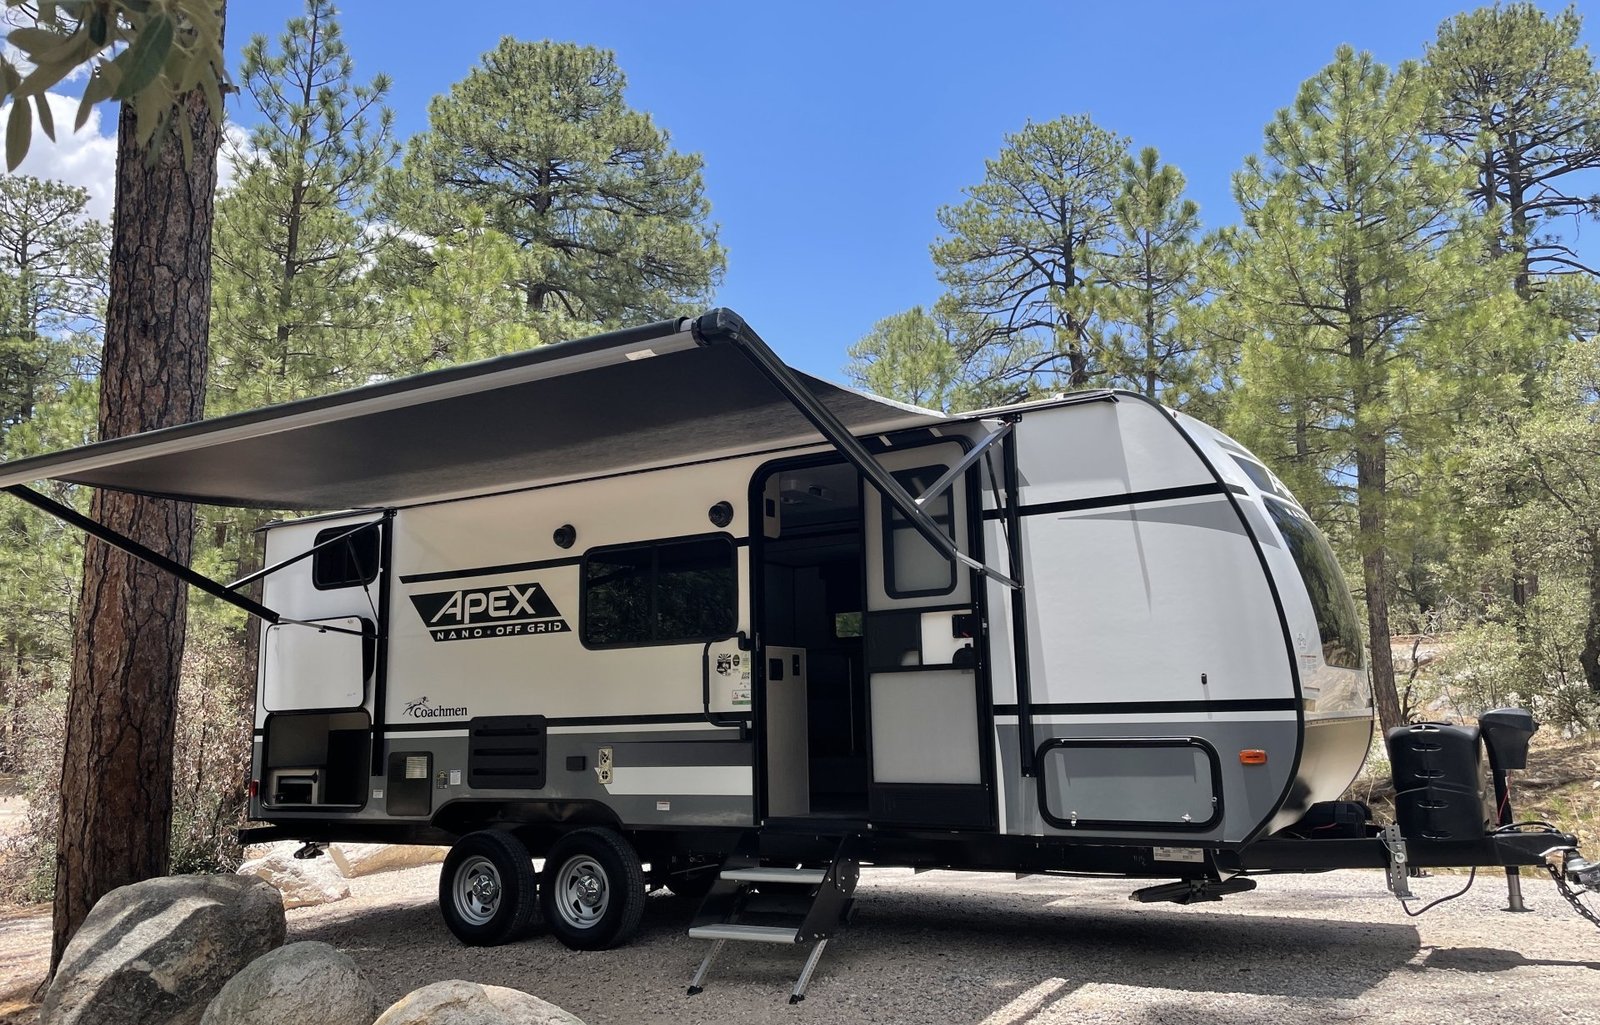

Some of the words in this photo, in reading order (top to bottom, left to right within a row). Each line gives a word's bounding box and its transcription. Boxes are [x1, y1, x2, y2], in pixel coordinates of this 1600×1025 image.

[430, 585, 537, 624] APEX
[436, 629, 483, 640] NANO
[495, 625, 522, 635] OFF
[527, 622, 562, 633] GRID
[413, 704, 468, 718] Coachmen
